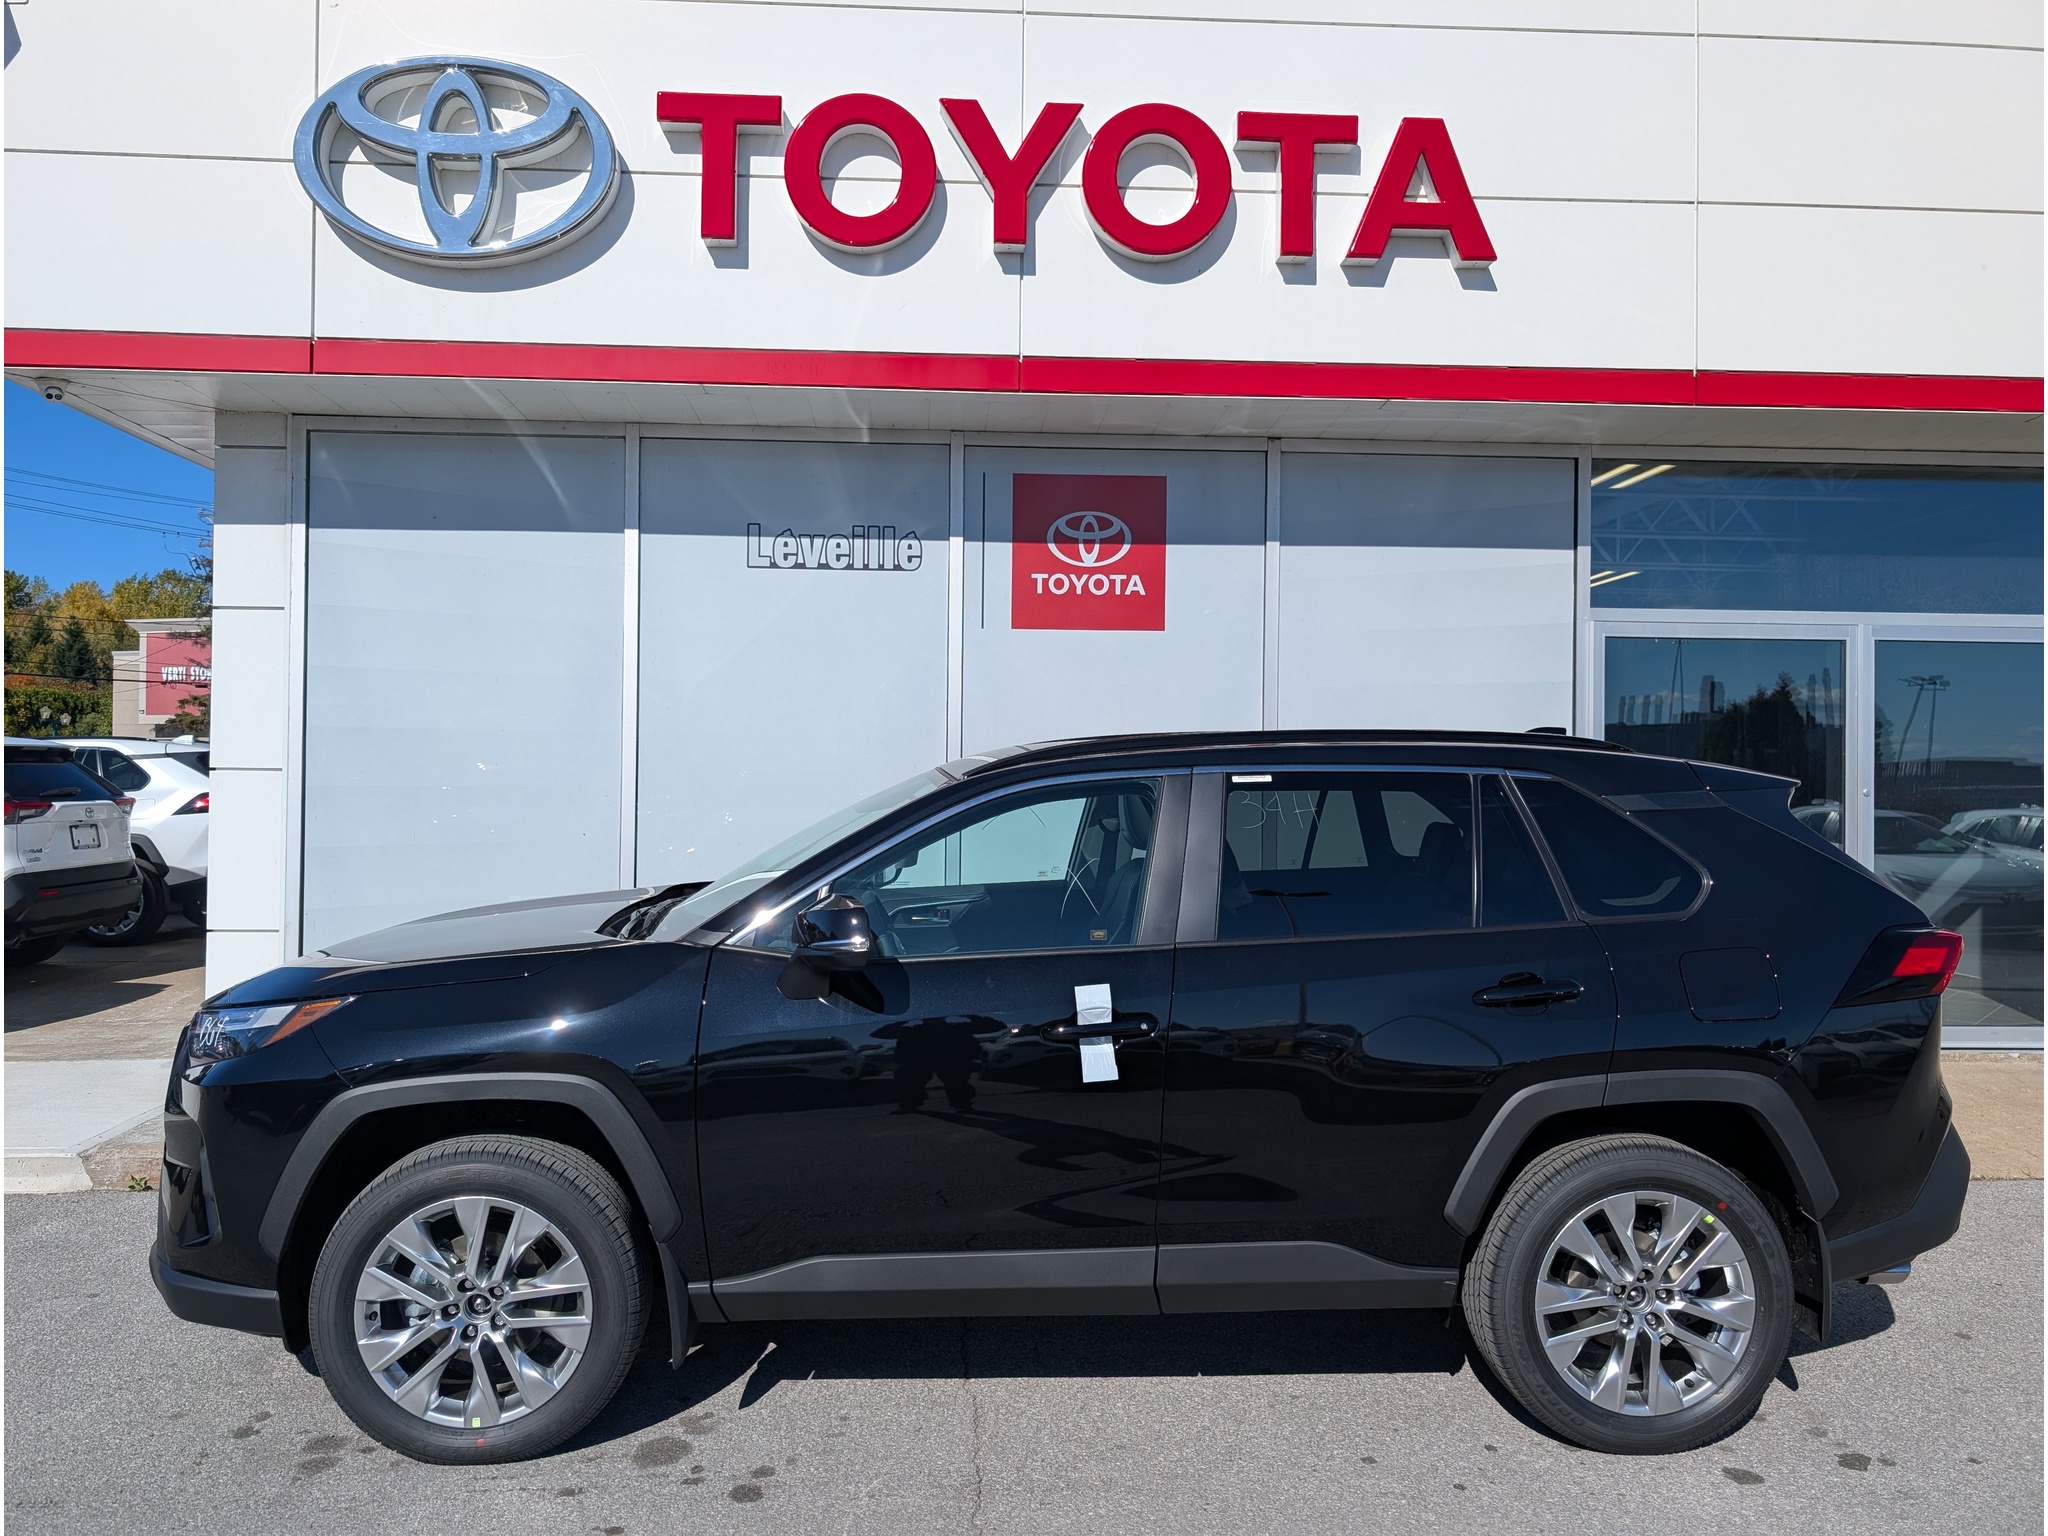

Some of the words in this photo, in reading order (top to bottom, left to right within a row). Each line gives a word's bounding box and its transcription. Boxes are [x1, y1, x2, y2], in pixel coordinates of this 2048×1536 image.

[656, 91, 1498, 267] TOYOTA
[747, 522, 923, 572] Léveillé
[1031, 573, 1146, 596] TOYOTA
[161, 666, 187, 682] VERTI
